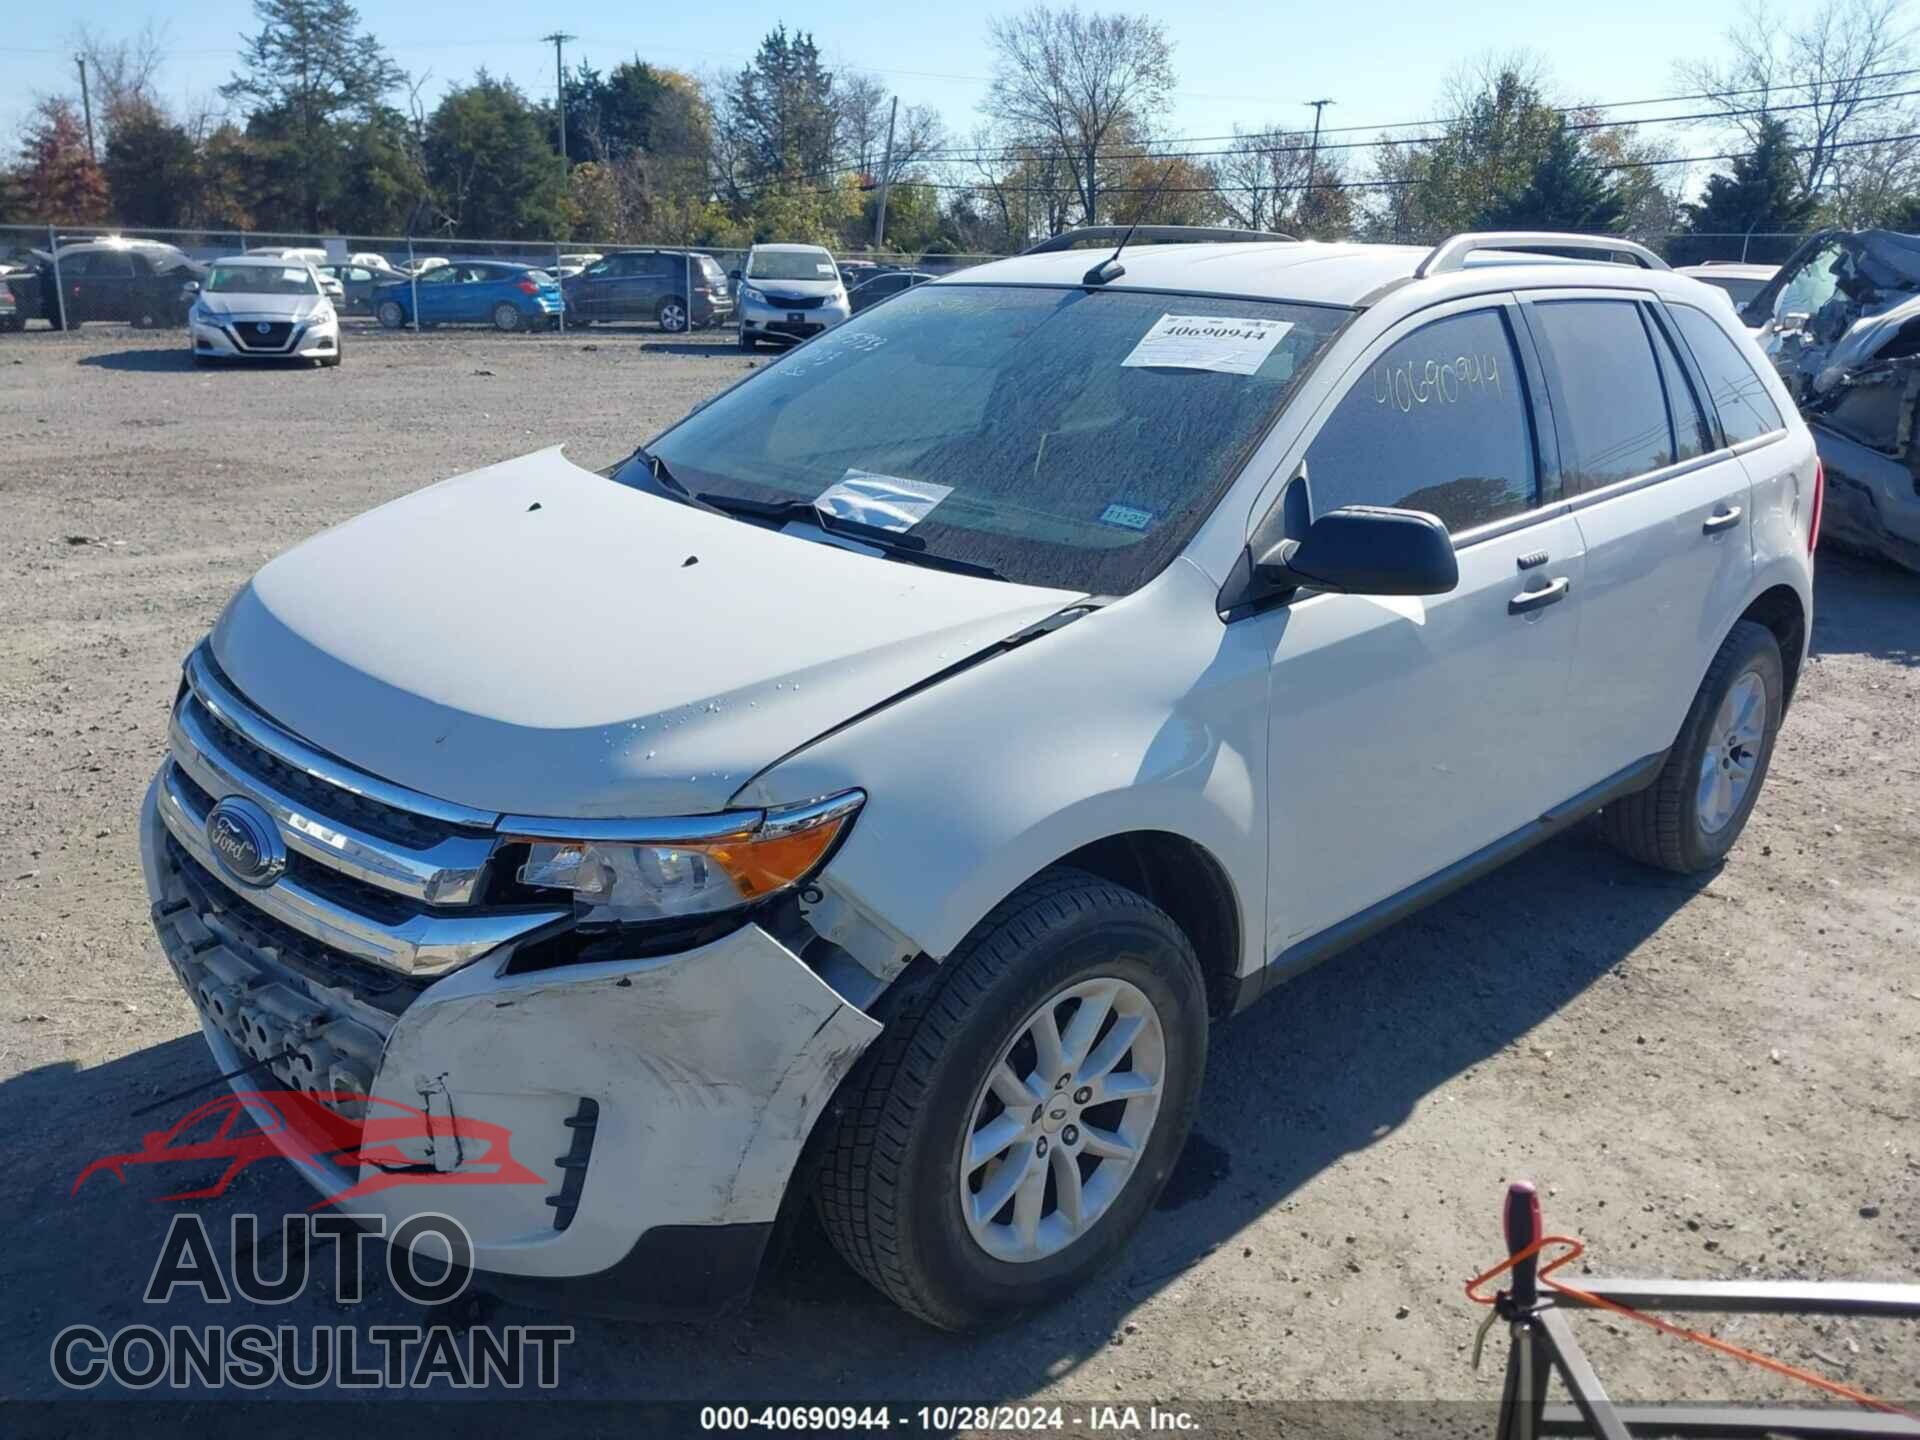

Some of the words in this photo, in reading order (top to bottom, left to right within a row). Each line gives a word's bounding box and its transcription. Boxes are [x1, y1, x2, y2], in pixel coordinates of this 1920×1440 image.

[1163, 325, 1267, 341] 40690944
[1372, 353, 1502, 413] 40690944
[212, 816, 256, 862] Ford
